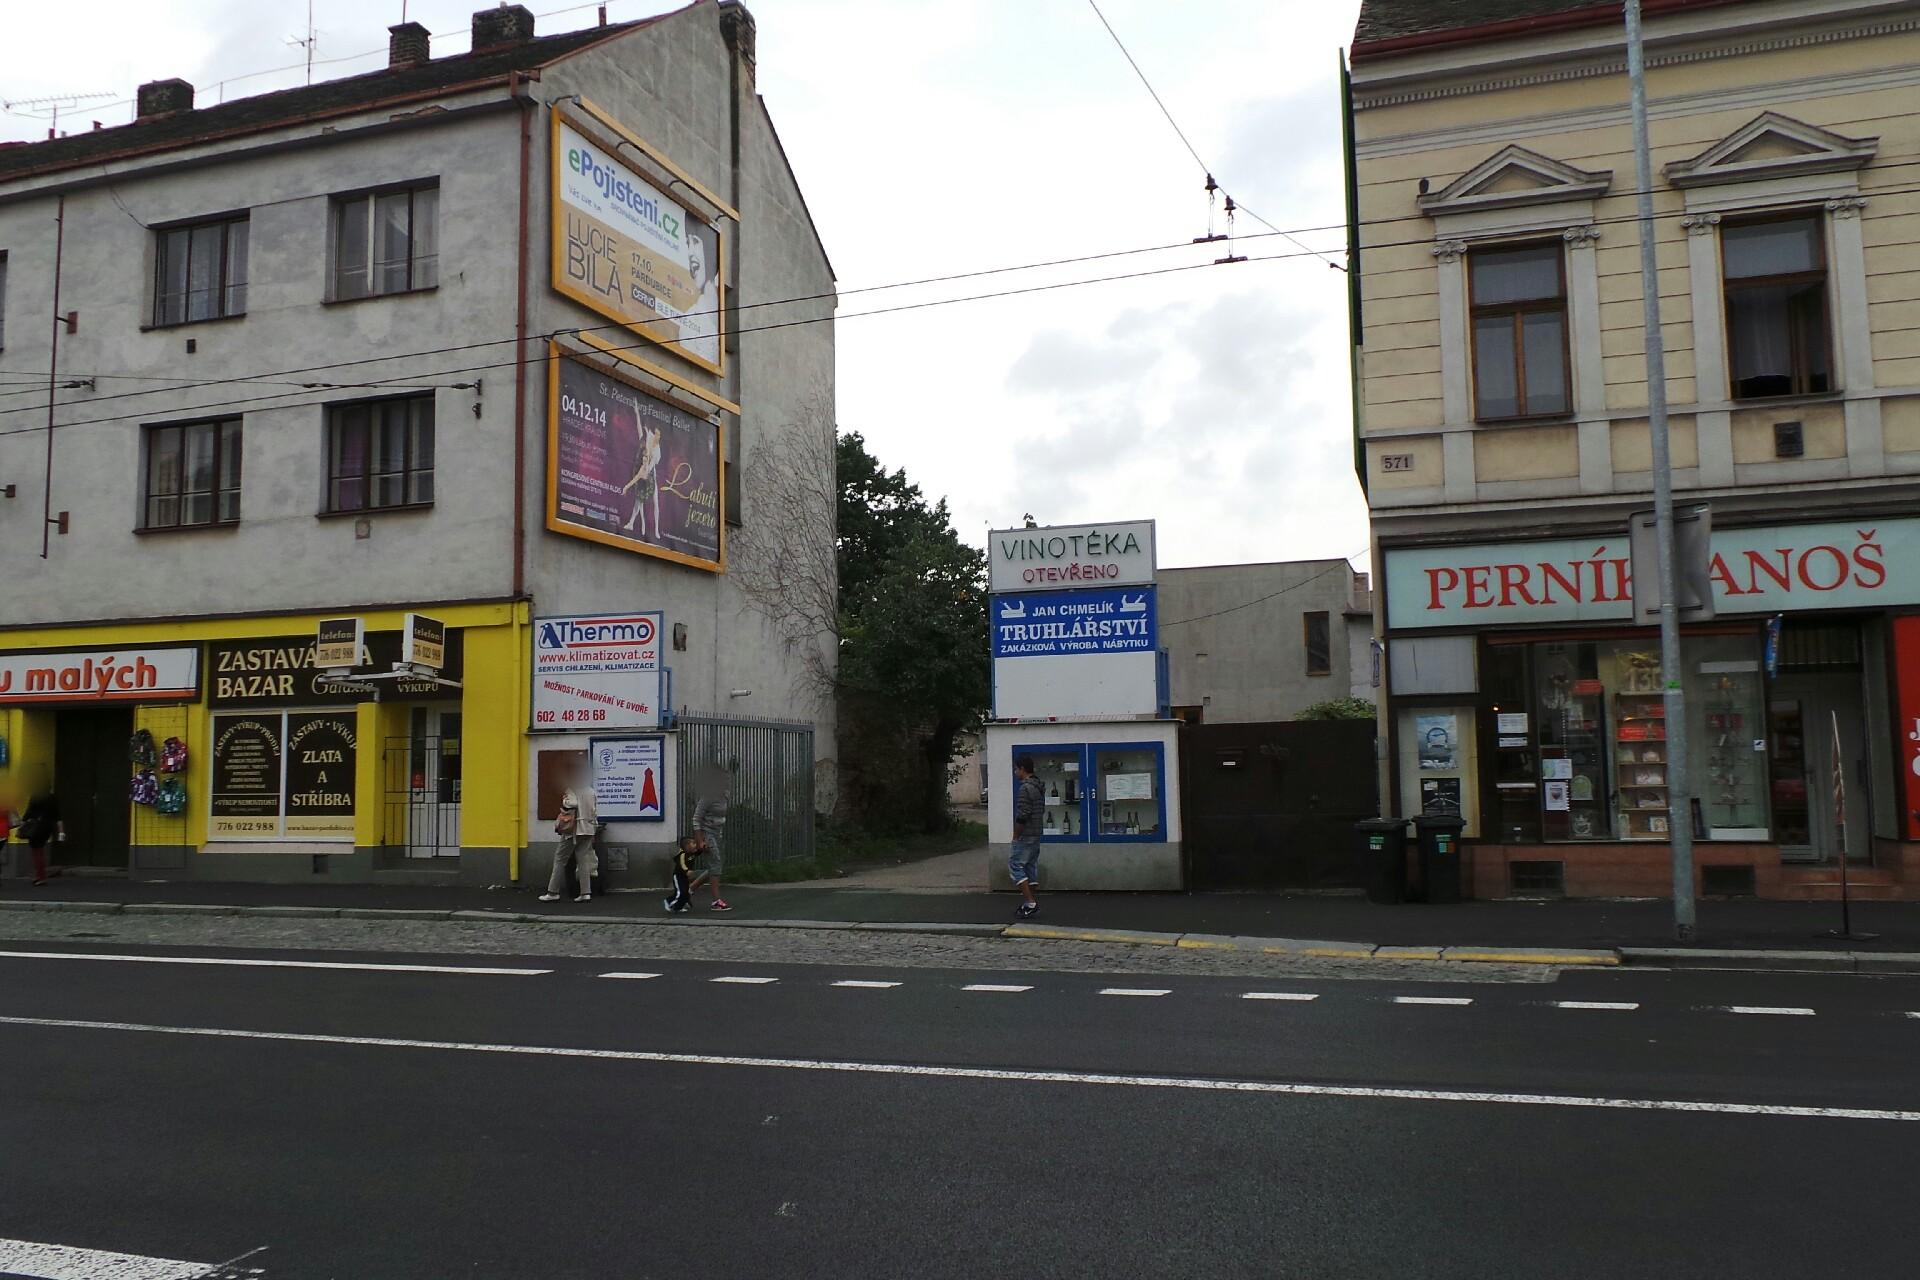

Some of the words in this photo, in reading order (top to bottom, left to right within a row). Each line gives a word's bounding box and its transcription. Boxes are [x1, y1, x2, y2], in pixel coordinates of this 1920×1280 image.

[568, 149, 679, 240] ePojisteni.cz
[568, 212, 617, 265] LUCIE
[632, 252, 654, 275] 17.10.
[631, 266, 673, 299] PARDUBICE
[562, 395, 607, 428] 04.12.14
[672, 415, 691, 433] Ballet
[1384, 456, 1409, 469] 571
[685, 504, 716, 528] jezero
[1001, 530, 1141, 561] VINOTÉKA
[1023, 562, 1119, 583] OTEVŘENO
[1709, 528, 1886, 595] ANOŠ
[1032, 605, 1056, 617] JAN
[1059, 601, 1114, 616] CHMELÍK
[555, 621, 650, 642] Thermo
[1000, 613, 1149, 641] TRUHLÁŘSTVÍ
[218, 641, 374, 672] ZASTAVÁA
[538, 650, 655, 663] www.klimatizovat.cz
[1001, 641, 1056, 653] ZAKÁZKOVÁ
[1060, 640, 1099, 651] VÝROBA
[1103, 639, 1149, 649] NÁBYTKU
[26, 655, 157, 698] malých
[565, 663, 604, 672] CHLAZENÍ,
[605, 662, 655, 671] KLIMATIZACE
[217, 674, 295, 698] BAZAR
[544, 680, 576, 696] MOŽNOST
[576, 688, 616, 706] PARKOVÁNÍ
[616, 697, 626, 708] VE
[626, 701, 649, 714] DVOŘE
[537, 710, 555, 722] 602
[562, 710, 574, 721] 48
[577, 709, 590, 721] 28
[592, 709, 606, 721] 68
[302, 750, 343, 763] ZLATA
[317, 770, 328, 783] A
[291, 790, 352, 807] STŘÍBRA
[217, 822, 233, 831] 776
[236, 822, 254, 831] 022
[256, 821, 275, 831] 988
